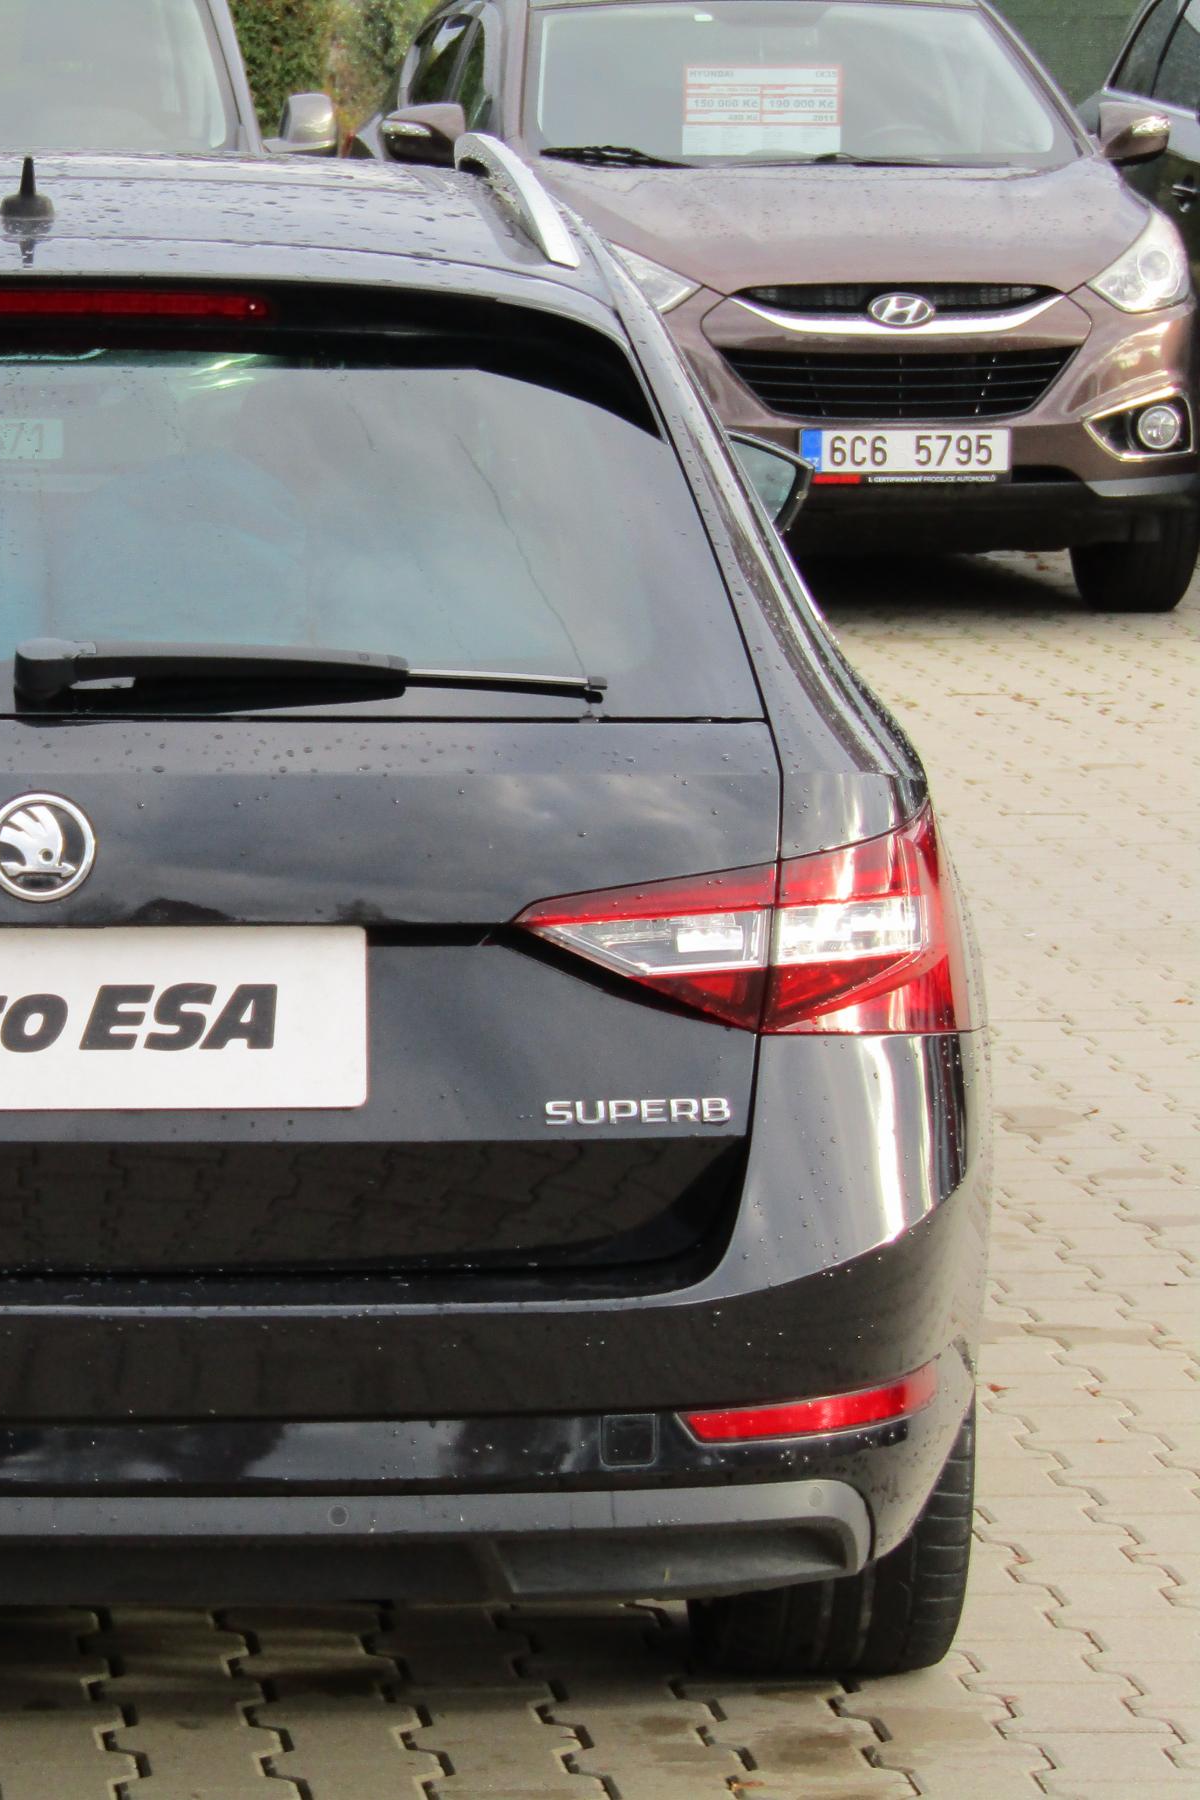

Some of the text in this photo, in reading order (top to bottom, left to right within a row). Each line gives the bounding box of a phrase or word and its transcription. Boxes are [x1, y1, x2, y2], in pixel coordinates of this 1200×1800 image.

[829, 435, 888, 467] 6C6
[914, 435, 993, 466] 5795
[79, 983, 278, 1051] ESA
[544, 1097, 731, 1125] SUPERB
